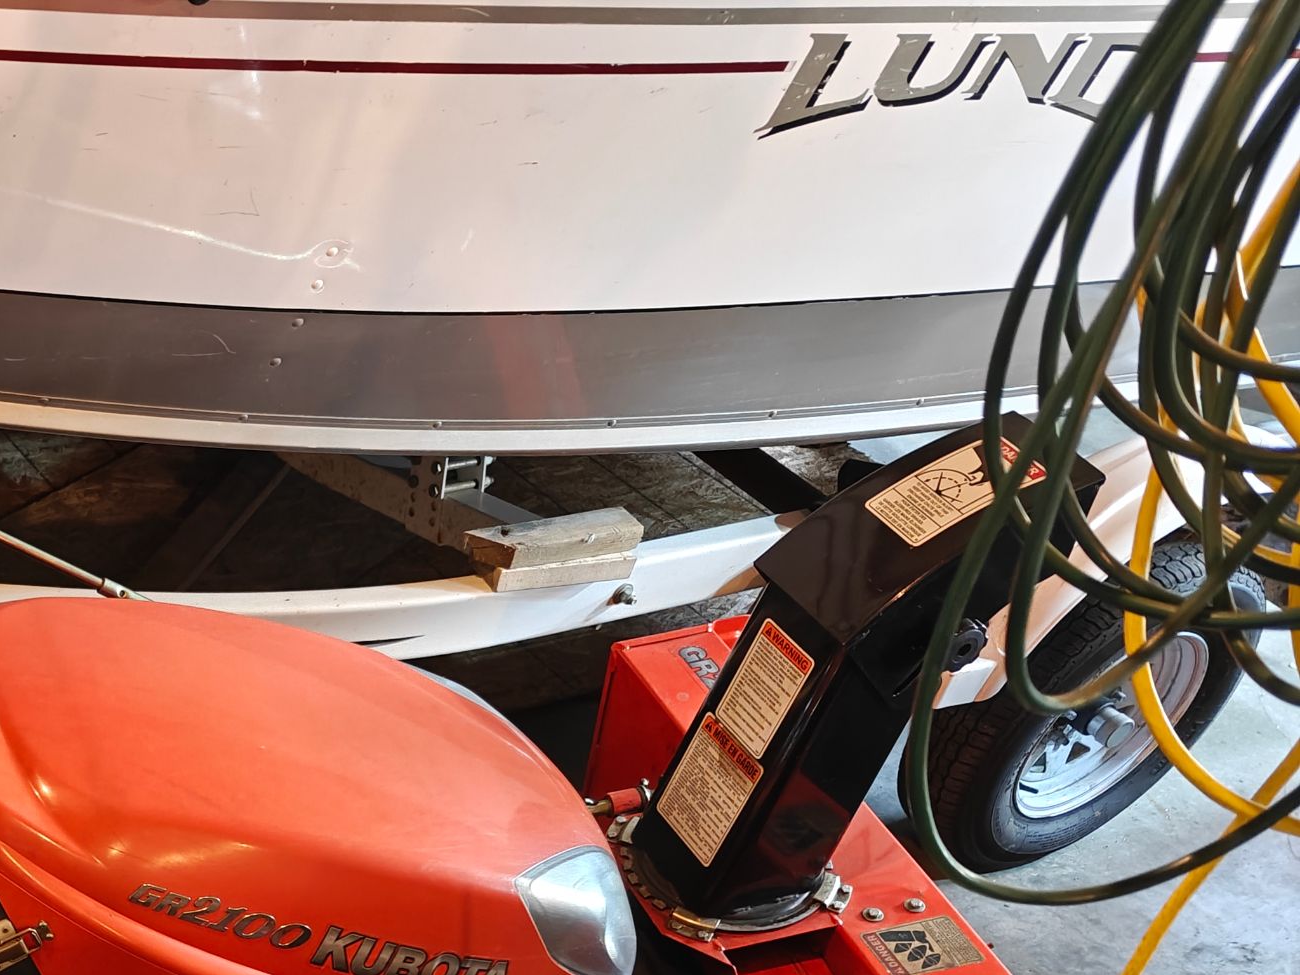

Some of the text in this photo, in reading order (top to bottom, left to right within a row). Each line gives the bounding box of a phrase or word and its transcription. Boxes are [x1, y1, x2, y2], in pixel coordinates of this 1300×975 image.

[753, 32, 1150, 140] LUND
[772, 633, 809, 671] WARNING
[713, 727, 758, 781] MISE EN GARDE
[127, 882, 313, 950] GR2100
[866, 934, 898, 968] DANGER
